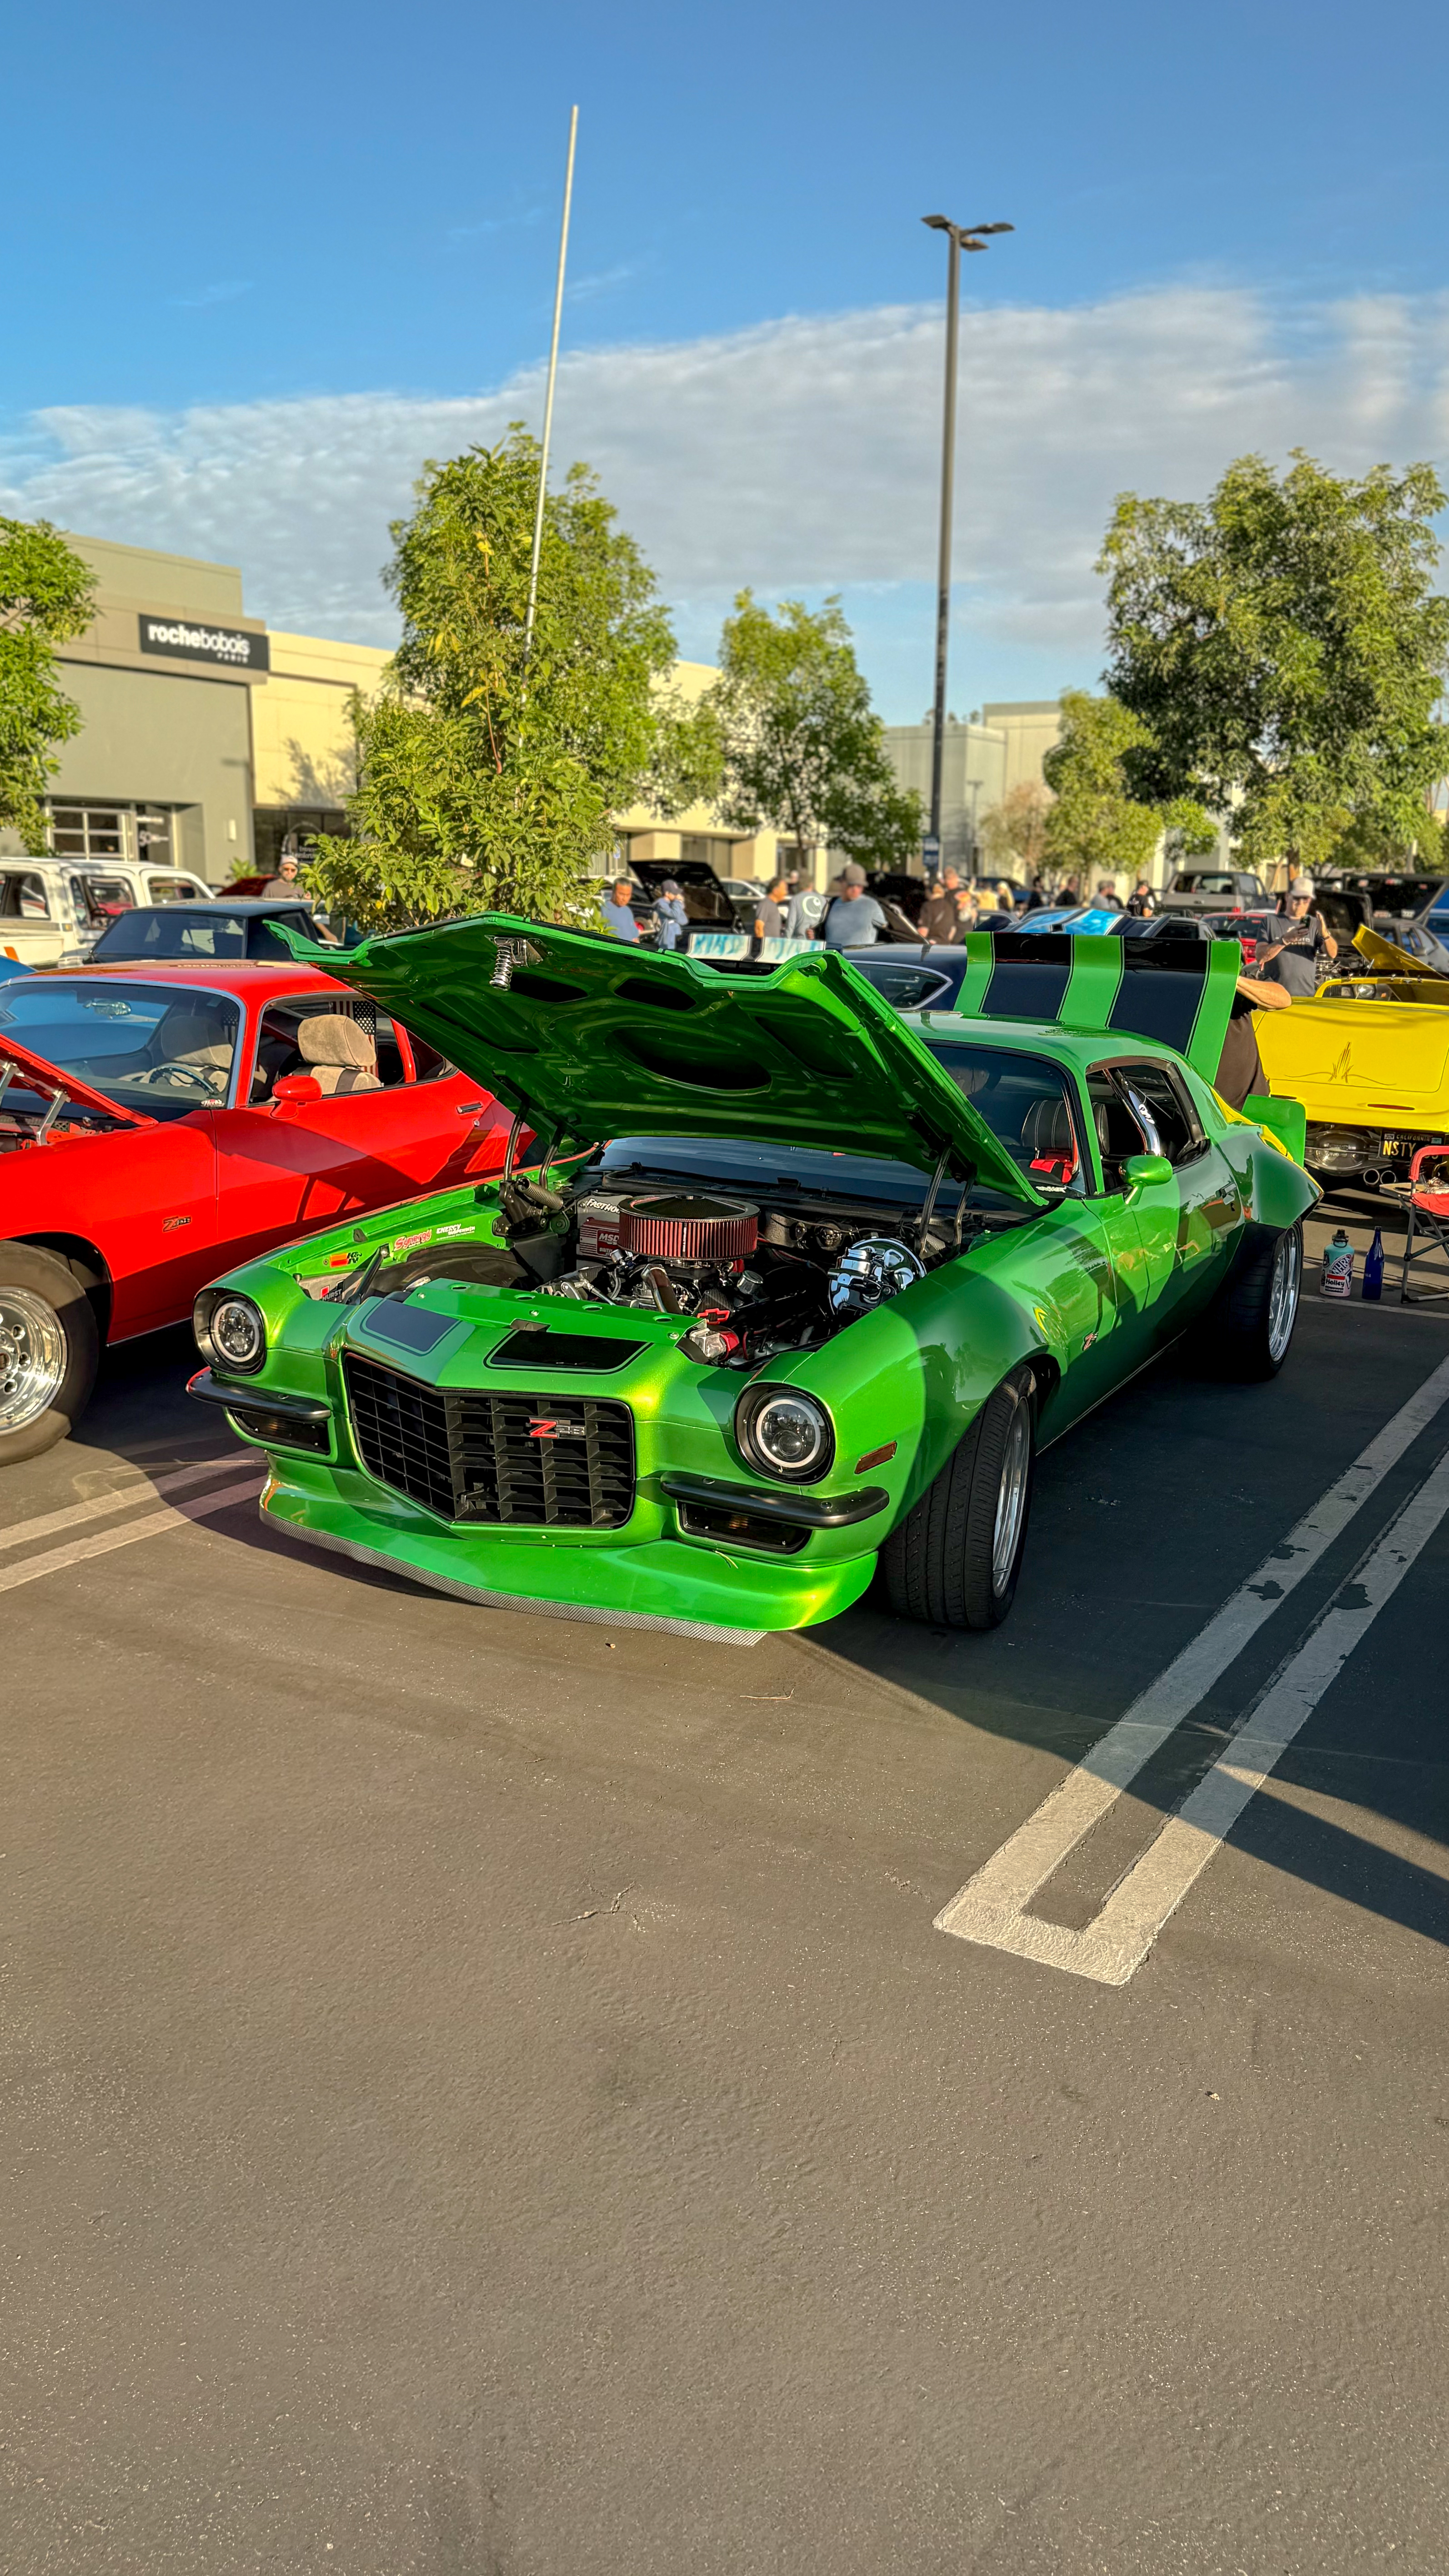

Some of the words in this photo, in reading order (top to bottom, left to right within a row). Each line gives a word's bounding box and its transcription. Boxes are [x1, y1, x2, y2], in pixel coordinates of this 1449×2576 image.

[1383, 1140, 1416, 1158] NSTY
[598, 1233, 619, 1242] MSD
[1325, 1278, 1345, 1288] Holley
[322, 1288, 342, 1301] HURST
